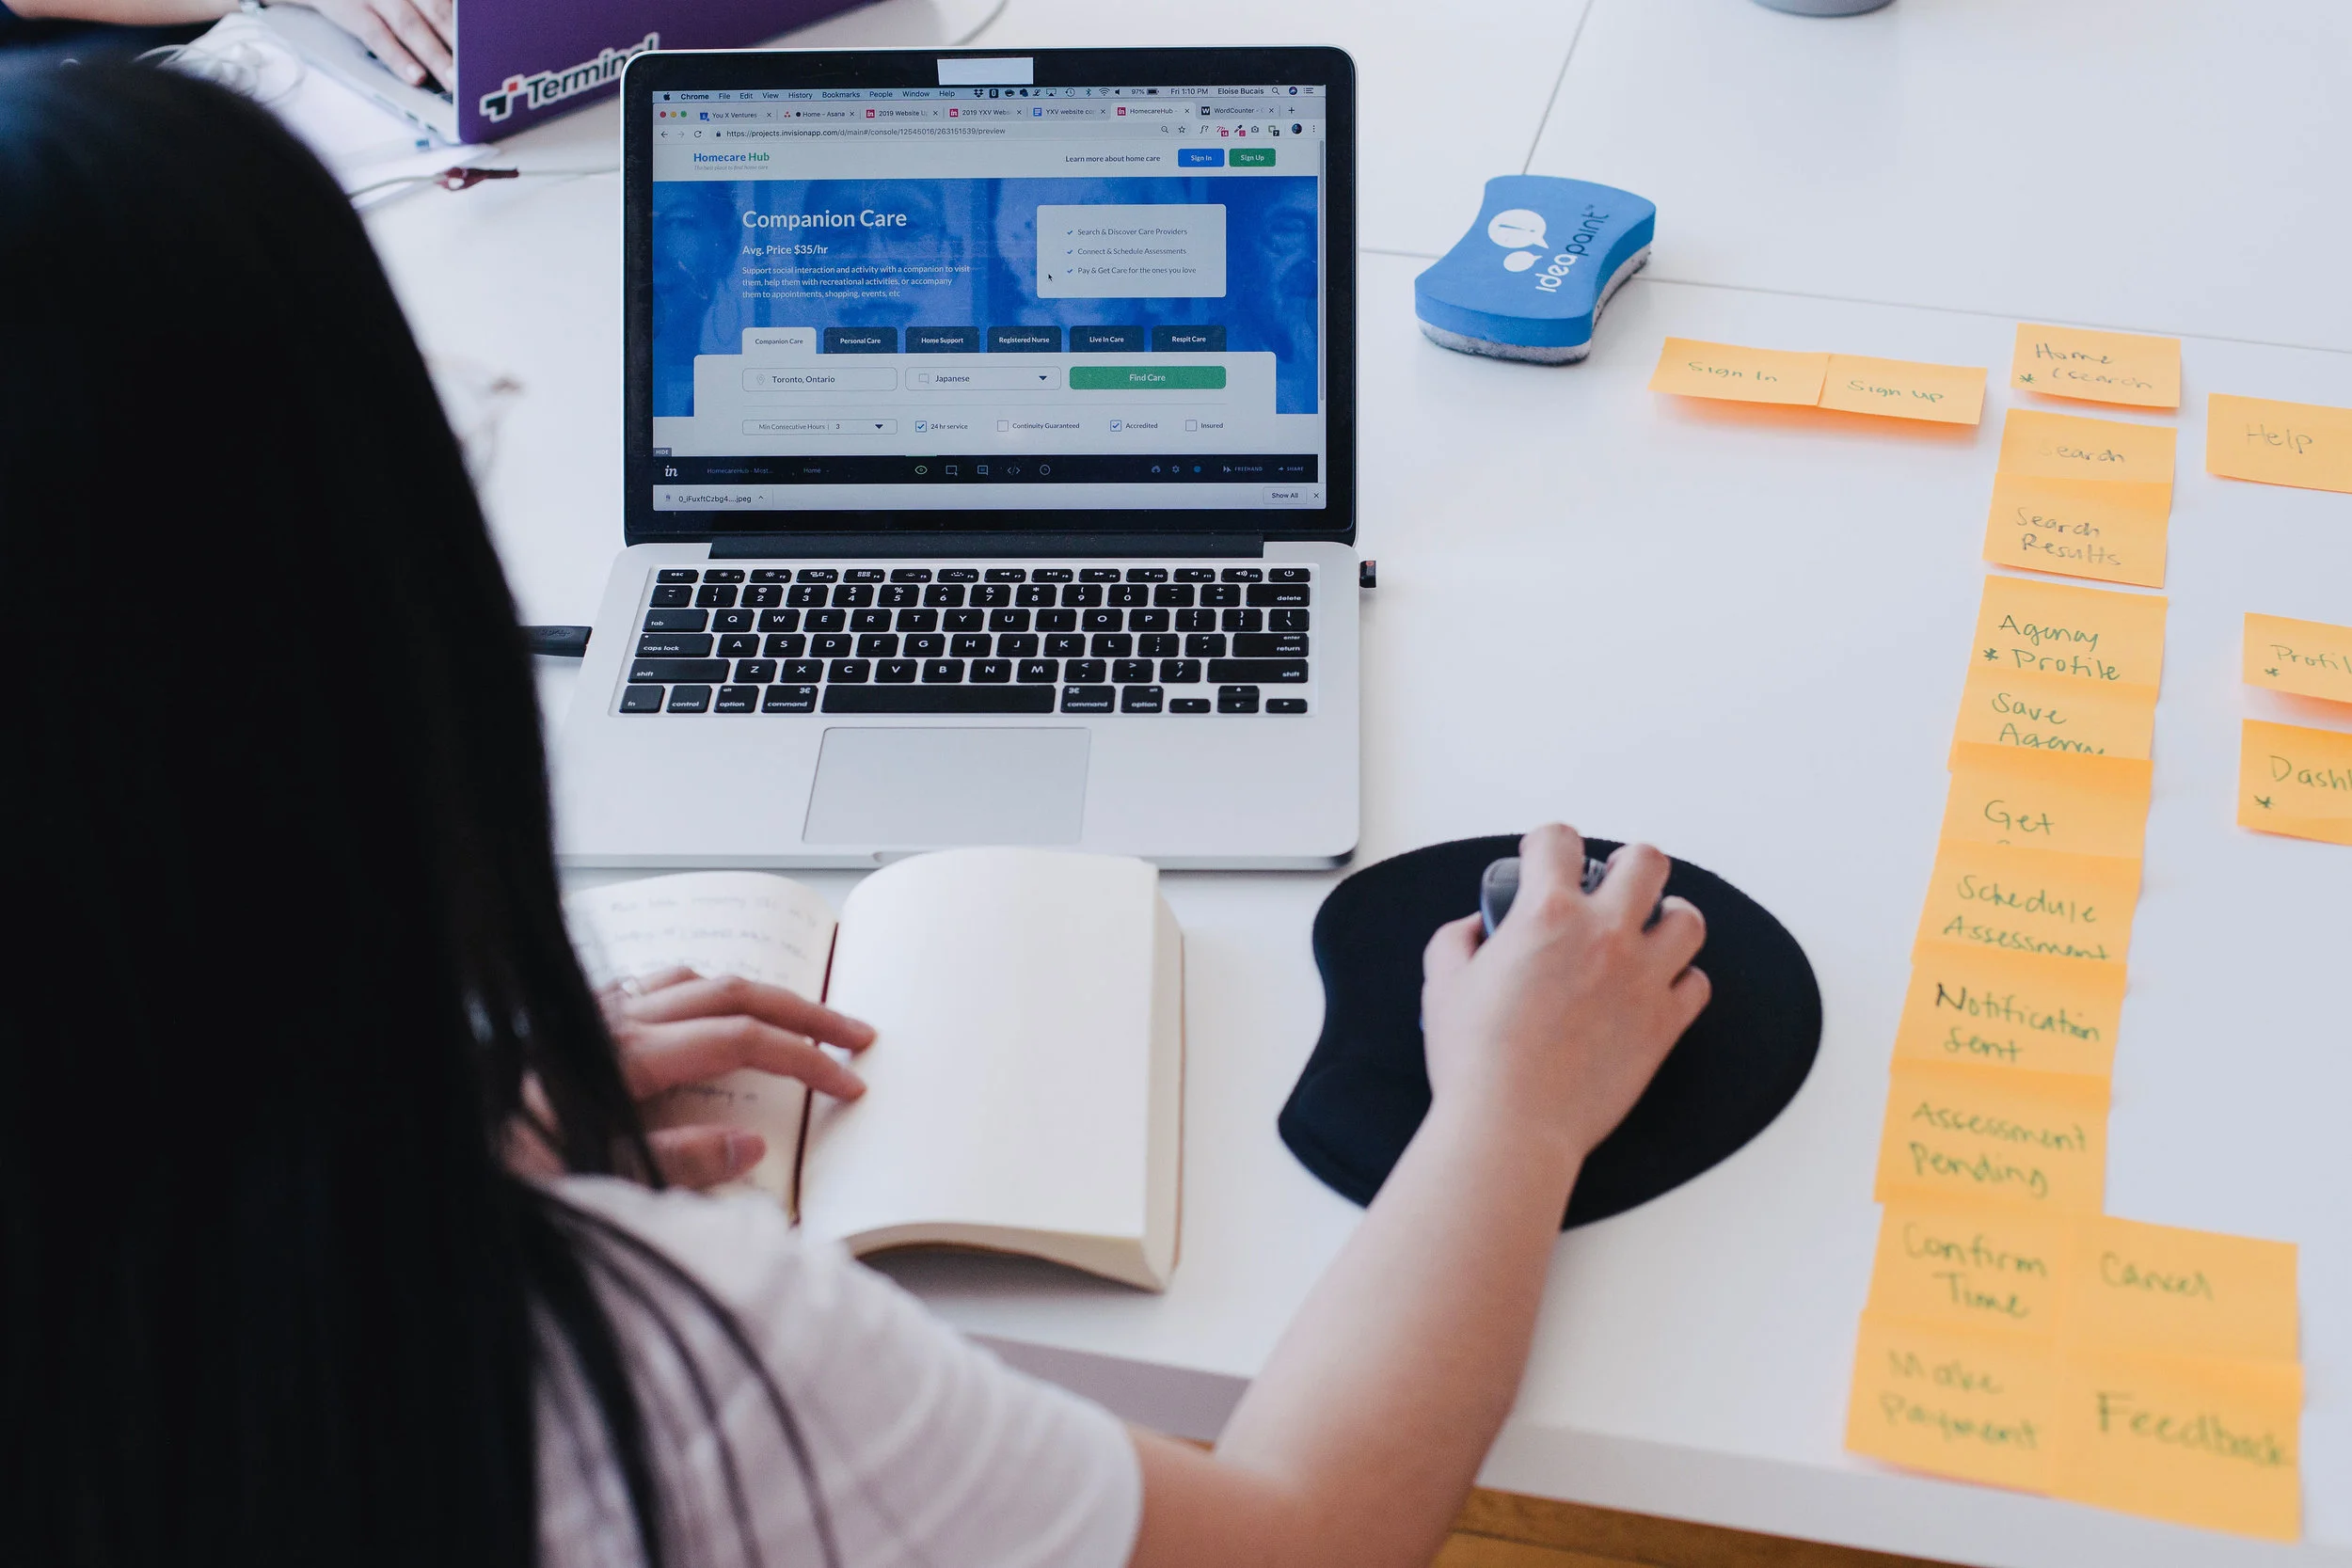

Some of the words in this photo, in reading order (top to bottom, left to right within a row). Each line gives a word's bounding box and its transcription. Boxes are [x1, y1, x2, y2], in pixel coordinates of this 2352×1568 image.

[788, 92, 813, 101] History
[869, 91, 893, 100] People
[939, 90, 956, 99] Help
[693, 152, 746, 163] Homecare
[748, 151, 770, 162] Hub
[742, 210, 855, 231] Companion
[860, 209, 908, 228] Care
[742, 245, 764, 257] Avg.
[767, 245, 792, 255] Price
[794, 244, 828, 256] $35/hr
[742, 266, 771, 275] Support
[795, 265, 834, 274] interaction
[851, 265, 879, 275] activity
[904, 265, 944, 274] companion
[742, 278, 763, 287] them,
[764, 278, 779, 287] help
[866, 277, 898, 286] activities,
[1077, 267, 1089, 276] Pay
[771, 290, 823, 299] appointments,
[825, 290, 859, 298] shopping,
[2036, 343, 2113, 364] Home
[772, 375, 804, 385] Toronto,
[935, 375, 970, 384] Japanese
[1130, 373, 1146, 382] Find
[1147, 373, 1166, 382] Care
[1688, 361, 1742, 378] Sign
[1847, 380, 1900, 397] Sign
[1012, 422, 1043, 431] Continuity
[2247, 423, 2313, 454] Help
[2016, 507, 2100, 537] Search
[2022, 533, 2122, 565] Results
[1998, 614, 2099, 652] Agency
[2012, 648, 2121, 680] Profile
[1992, 692, 2067, 724] Save
[1984, 800, 2055, 835] Get
[1958, 875, 2097, 923] Schedule
[1935, 983, 2101, 1041] Notification
[1912, 1101, 2088, 1150] Assessment
[1902, 1223, 2049, 1278] Confirm
[2099, 1251, 2214, 1300] Cancel
[1932, 1270, 2029, 1319] Time
[1887, 1349, 2004, 1394] Make
[2095, 1389, 2295, 1468] Feedback
